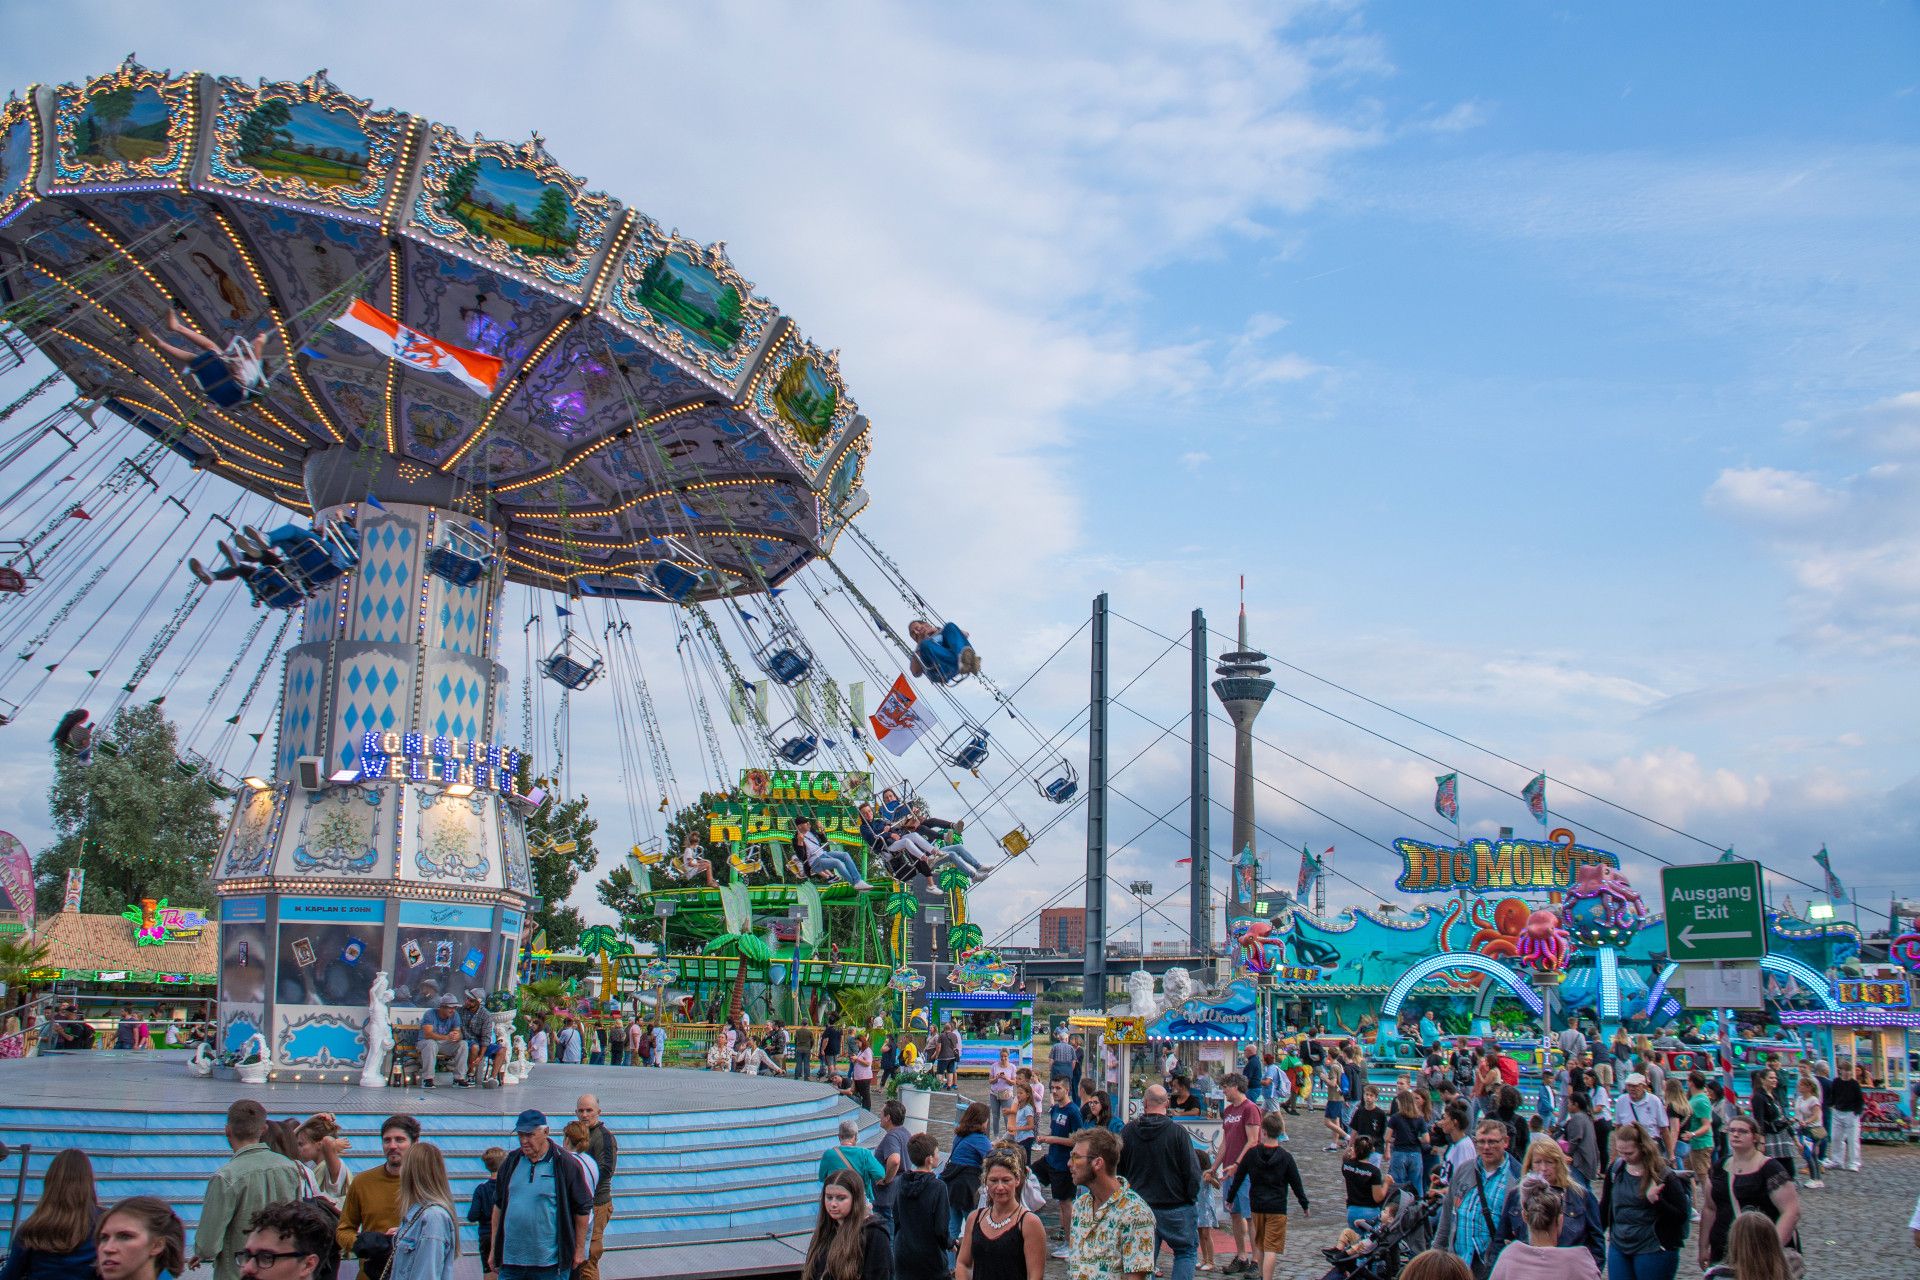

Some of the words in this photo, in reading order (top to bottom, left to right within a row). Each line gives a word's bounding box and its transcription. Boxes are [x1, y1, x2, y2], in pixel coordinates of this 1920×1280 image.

[772, 770, 840, 800] RIO
[1400, 843, 1471, 887] BIG
[1474, 843, 1614, 888] MONST
[1671, 886, 1752, 903] Ausgang
[159, 909, 185, 928] Tiki
[305, 905, 338, 913] KAPLAN
[1694, 905, 1730, 920] Exit
[1839, 982, 1905, 1004] KASSE
